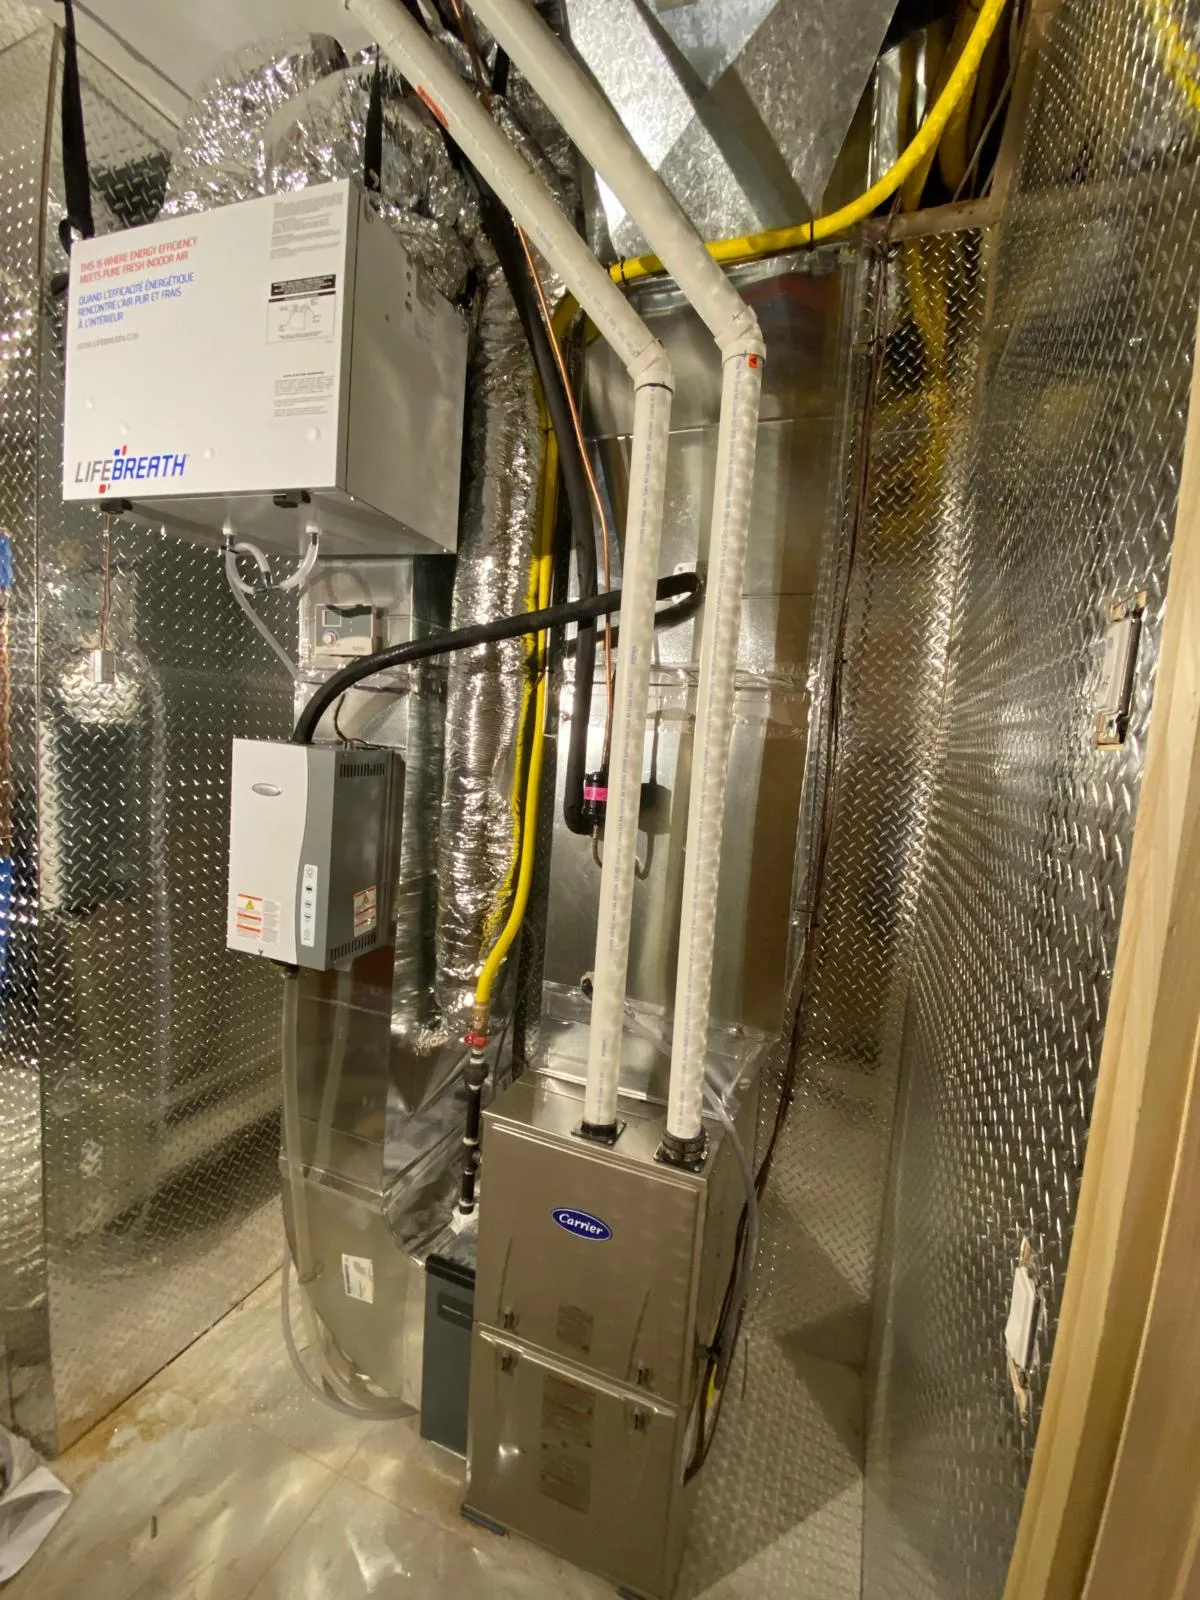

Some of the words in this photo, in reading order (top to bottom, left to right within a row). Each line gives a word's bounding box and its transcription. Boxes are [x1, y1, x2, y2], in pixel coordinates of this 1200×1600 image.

[79, 271, 102, 283] MEETS
[102, 267, 120, 278] PURE
[122, 261, 144, 273] FRESH
[146, 255, 174, 268] INDOOR
[175, 251, 188, 261] AIR
[80, 262, 94, 272] THIS
[95, 259, 103, 268] IS
[103, 253, 129, 266] WHERE
[130, 246, 157, 260] ENERGY
[158, 236, 197, 253] EFFICIENCY
[78, 293, 103, 305] QUAND
[144, 272, 194, 290] ÉNERGÉTIQUE
[78, 301, 117, 315] RENCONTRE
[134, 294, 150, 304] PUR
[151, 292, 161, 301] ET
[160, 287, 181, 299] FRAIS
[77, 318, 84, 330] À
[75, 454, 187, 483] LIFEBREATH
[558, 1213, 603, 1235] Carrier
